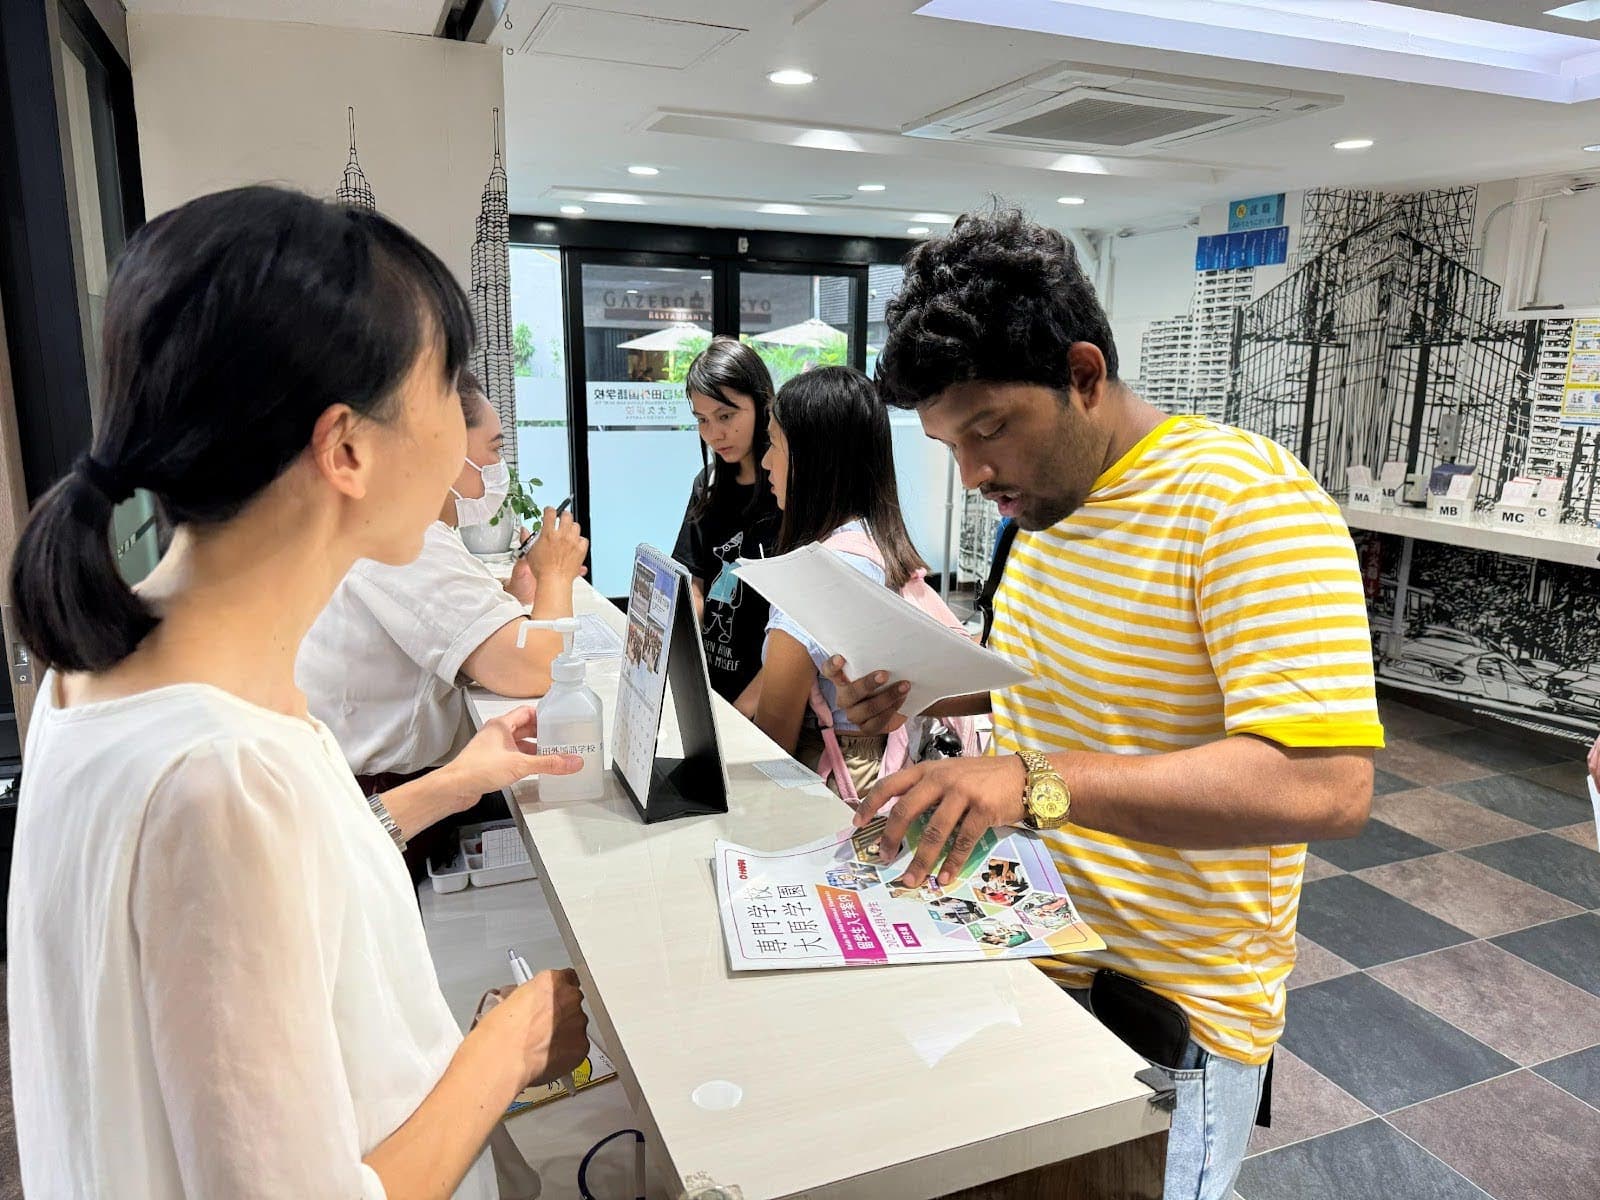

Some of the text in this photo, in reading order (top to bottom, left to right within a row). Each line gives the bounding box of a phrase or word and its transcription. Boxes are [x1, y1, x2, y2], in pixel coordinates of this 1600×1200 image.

[603, 290, 685, 308] GAZEBO
[1354, 492, 1370, 503] MA
[1439, 506, 1458, 516] MB
[1502, 512, 1525, 523] MC
[744, 886, 788, 954] 専門学校
[777, 885, 828, 952] 大原学園
[837, 894, 875, 950] 留学生入学案内
